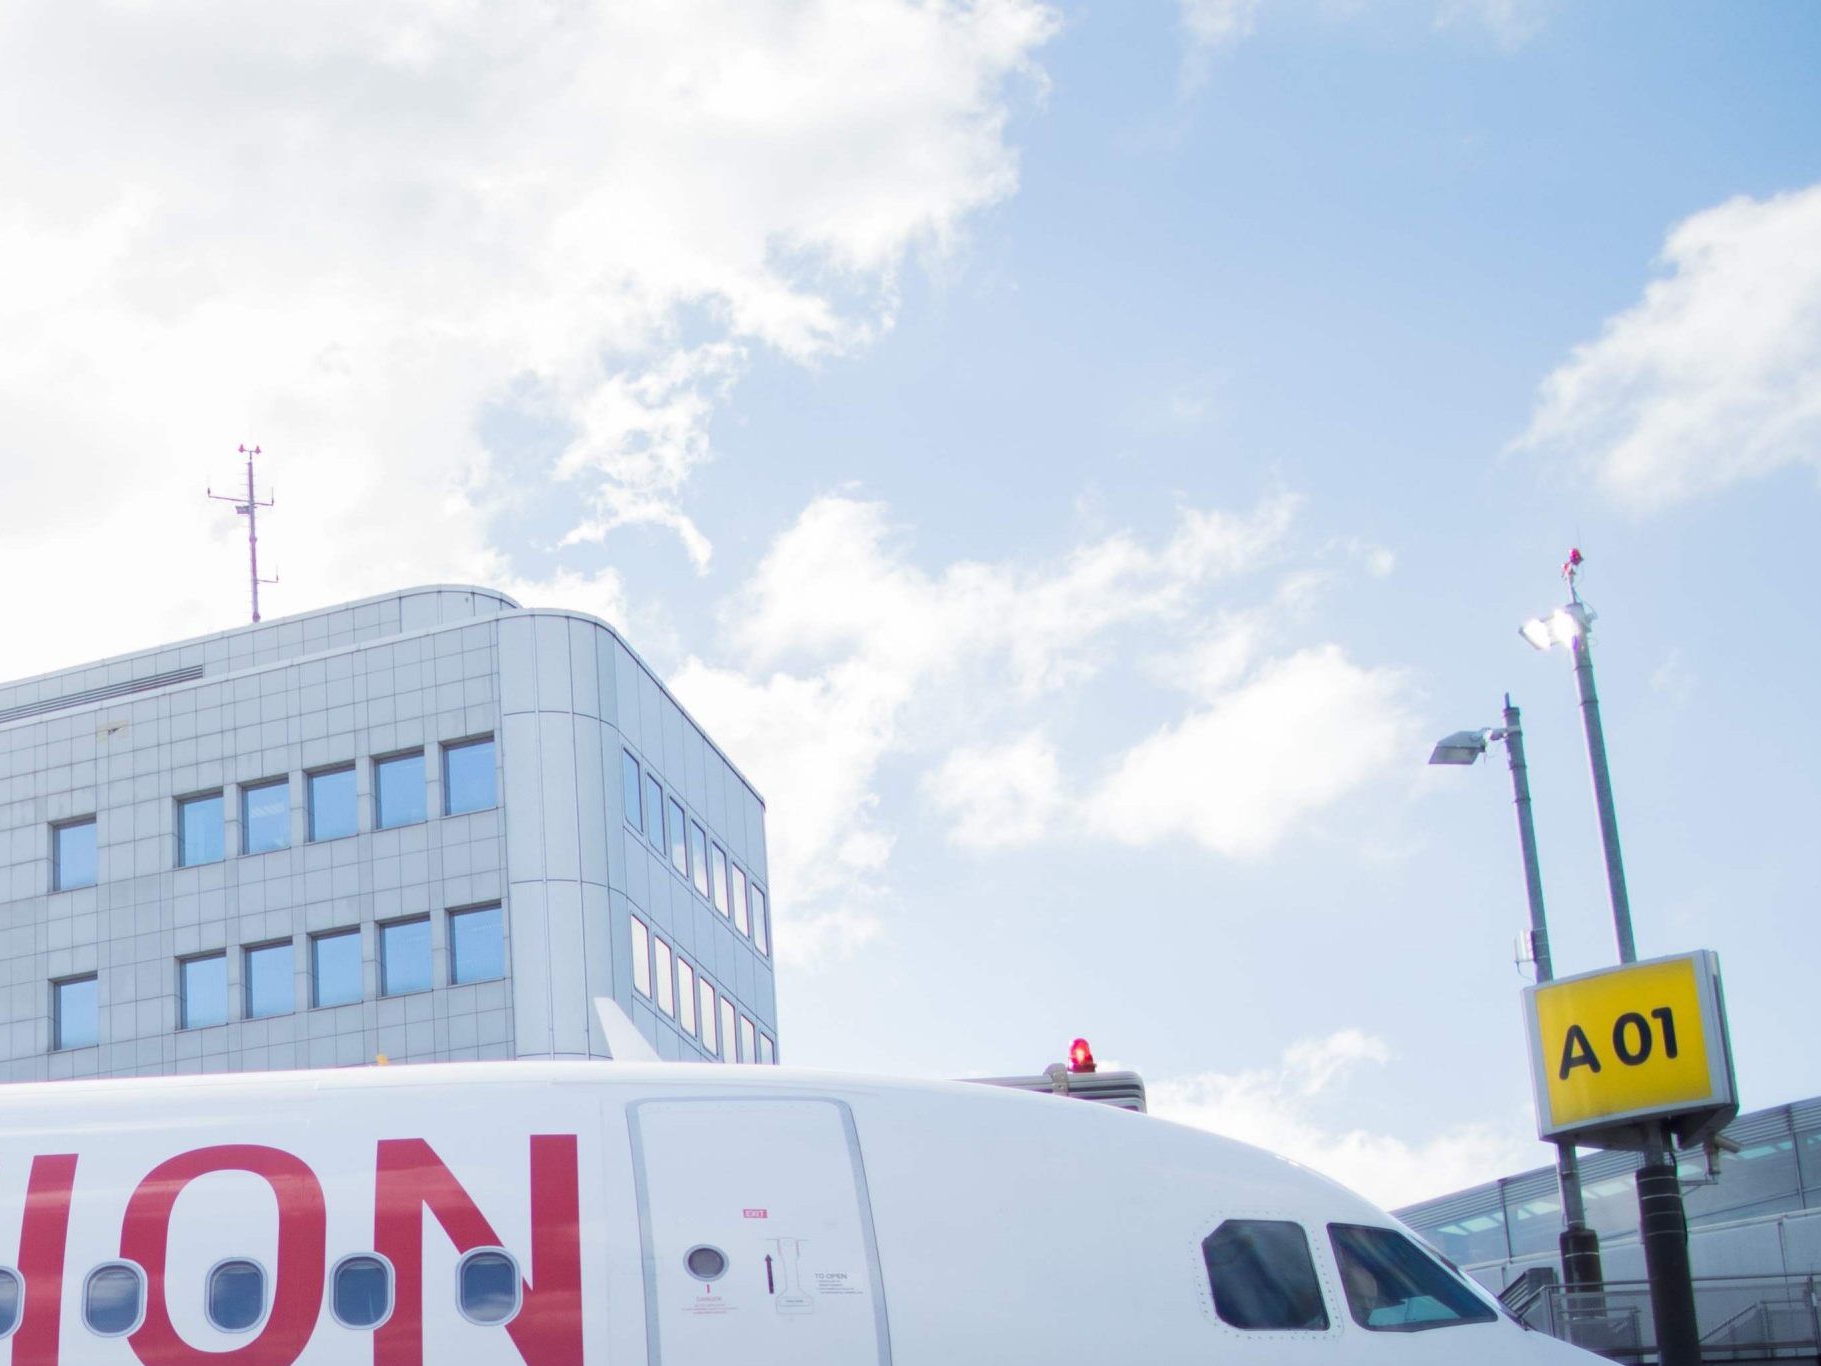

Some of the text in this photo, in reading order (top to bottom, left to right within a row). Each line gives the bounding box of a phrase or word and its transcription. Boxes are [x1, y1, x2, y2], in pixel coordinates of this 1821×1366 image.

[1559, 1007, 1678, 1080] A 01
[745, 1209, 765, 1218] EXIT
[814, 1272, 848, 1280] TO OPEN
